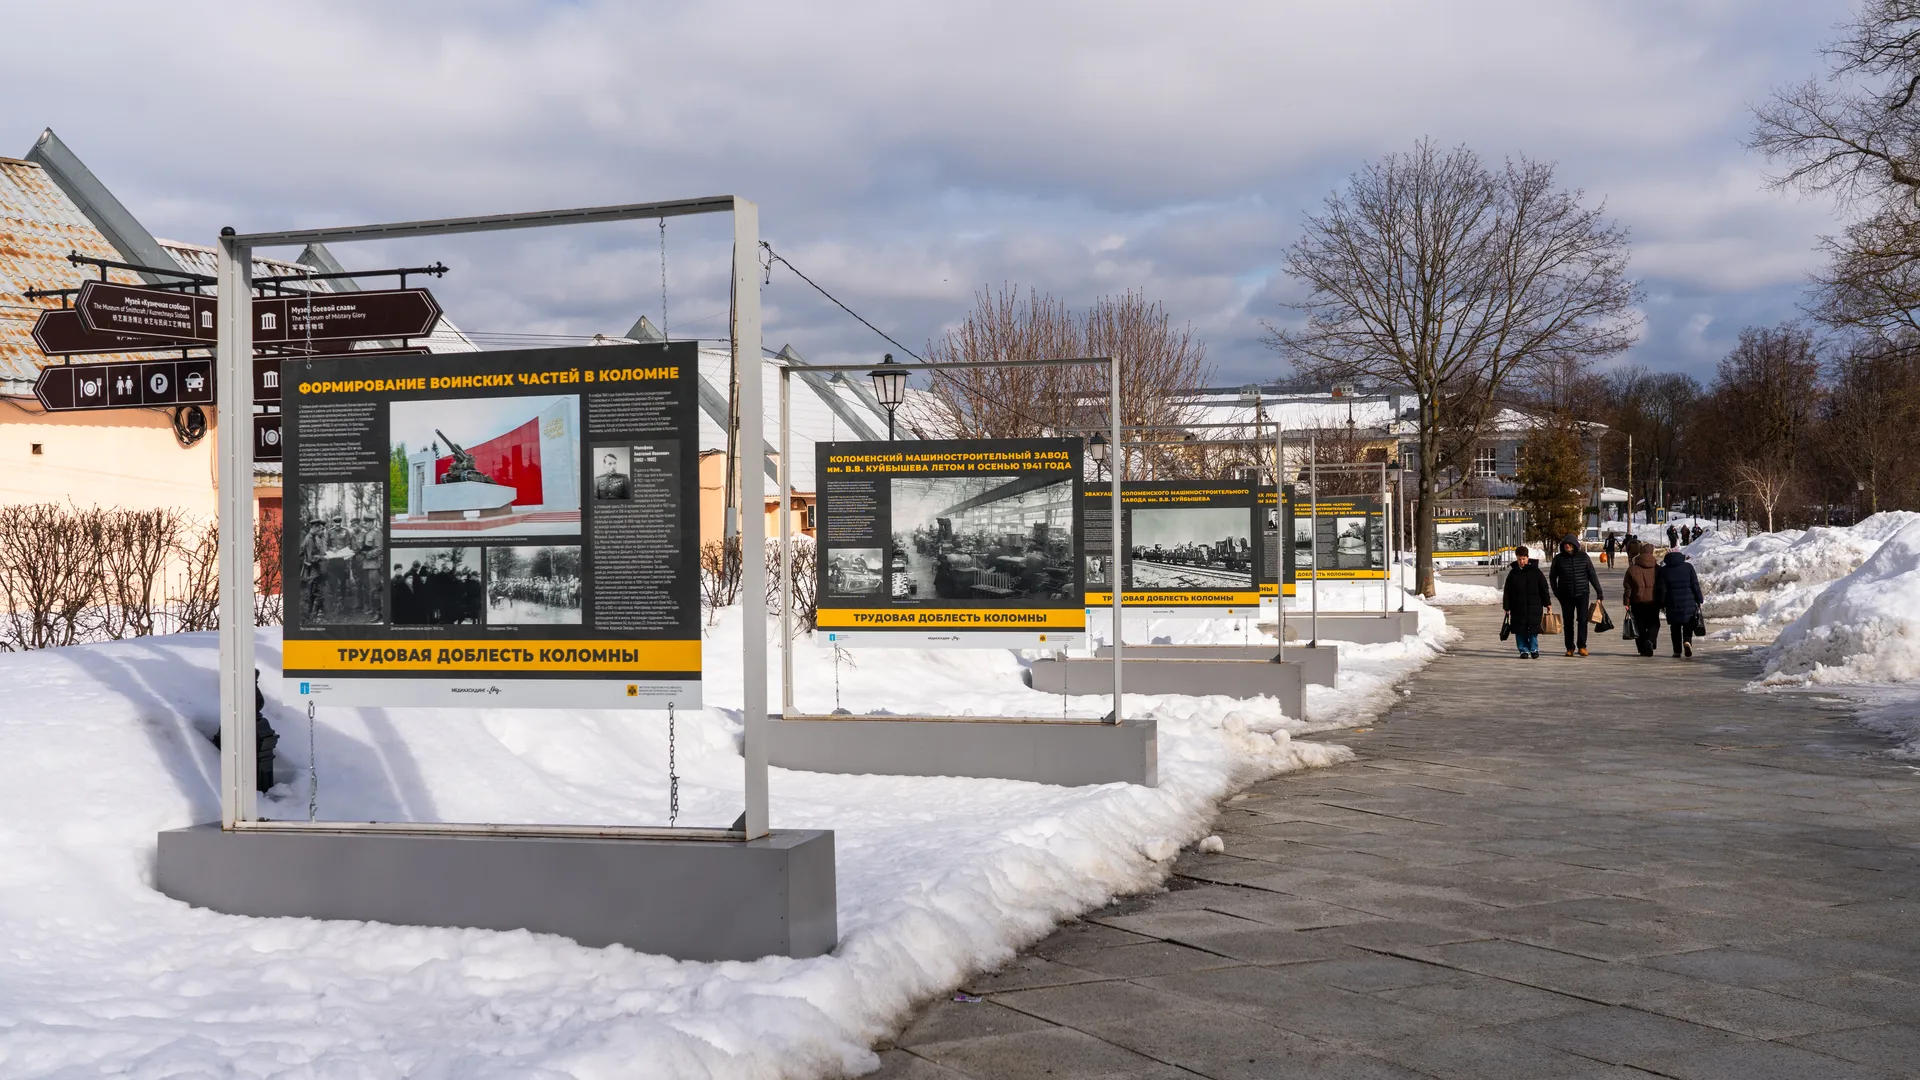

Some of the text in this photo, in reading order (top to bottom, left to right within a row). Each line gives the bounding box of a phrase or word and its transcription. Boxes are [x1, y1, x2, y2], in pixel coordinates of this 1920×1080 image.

[124, 297, 141, 306] Музей
[94, 302, 102, 310] The
[102, 304, 120, 312] Museum
[174, 312, 190, 320] Sloboda
[312, 304, 335, 312] боевой
[299, 366, 680, 395] ФОРМИРОВАНИЕ ВОИНСКИХ ЧАСТЕЙ В КОЛОМНЕ
[829, 451, 1069, 464] КОЛОМЕНСКИЙ МАШИНОСТРОИТЕЛЬНЫЙ ЗАВОД
[827, 461, 1073, 474] им. В.В. КУЙБЫШЕВА ЛЕТОМ И ОСЕНЬЮ 1941 ГОДА
[1171, 495, 1211, 503] КУЙБЫШЕВА
[1102, 595, 1145, 603] ТРОВАЯ
[1146, 595, 1189, 603] ДОБЛЕСТЬ
[853, 612, 1048, 623] ТРУДОВАЯ ДОБЛЕСТЬ КОЛОМНЫ
[337, 648, 639, 664] ТРУДОВАЯ ДОБЛЕСТЬ КОЛОМНЫ
